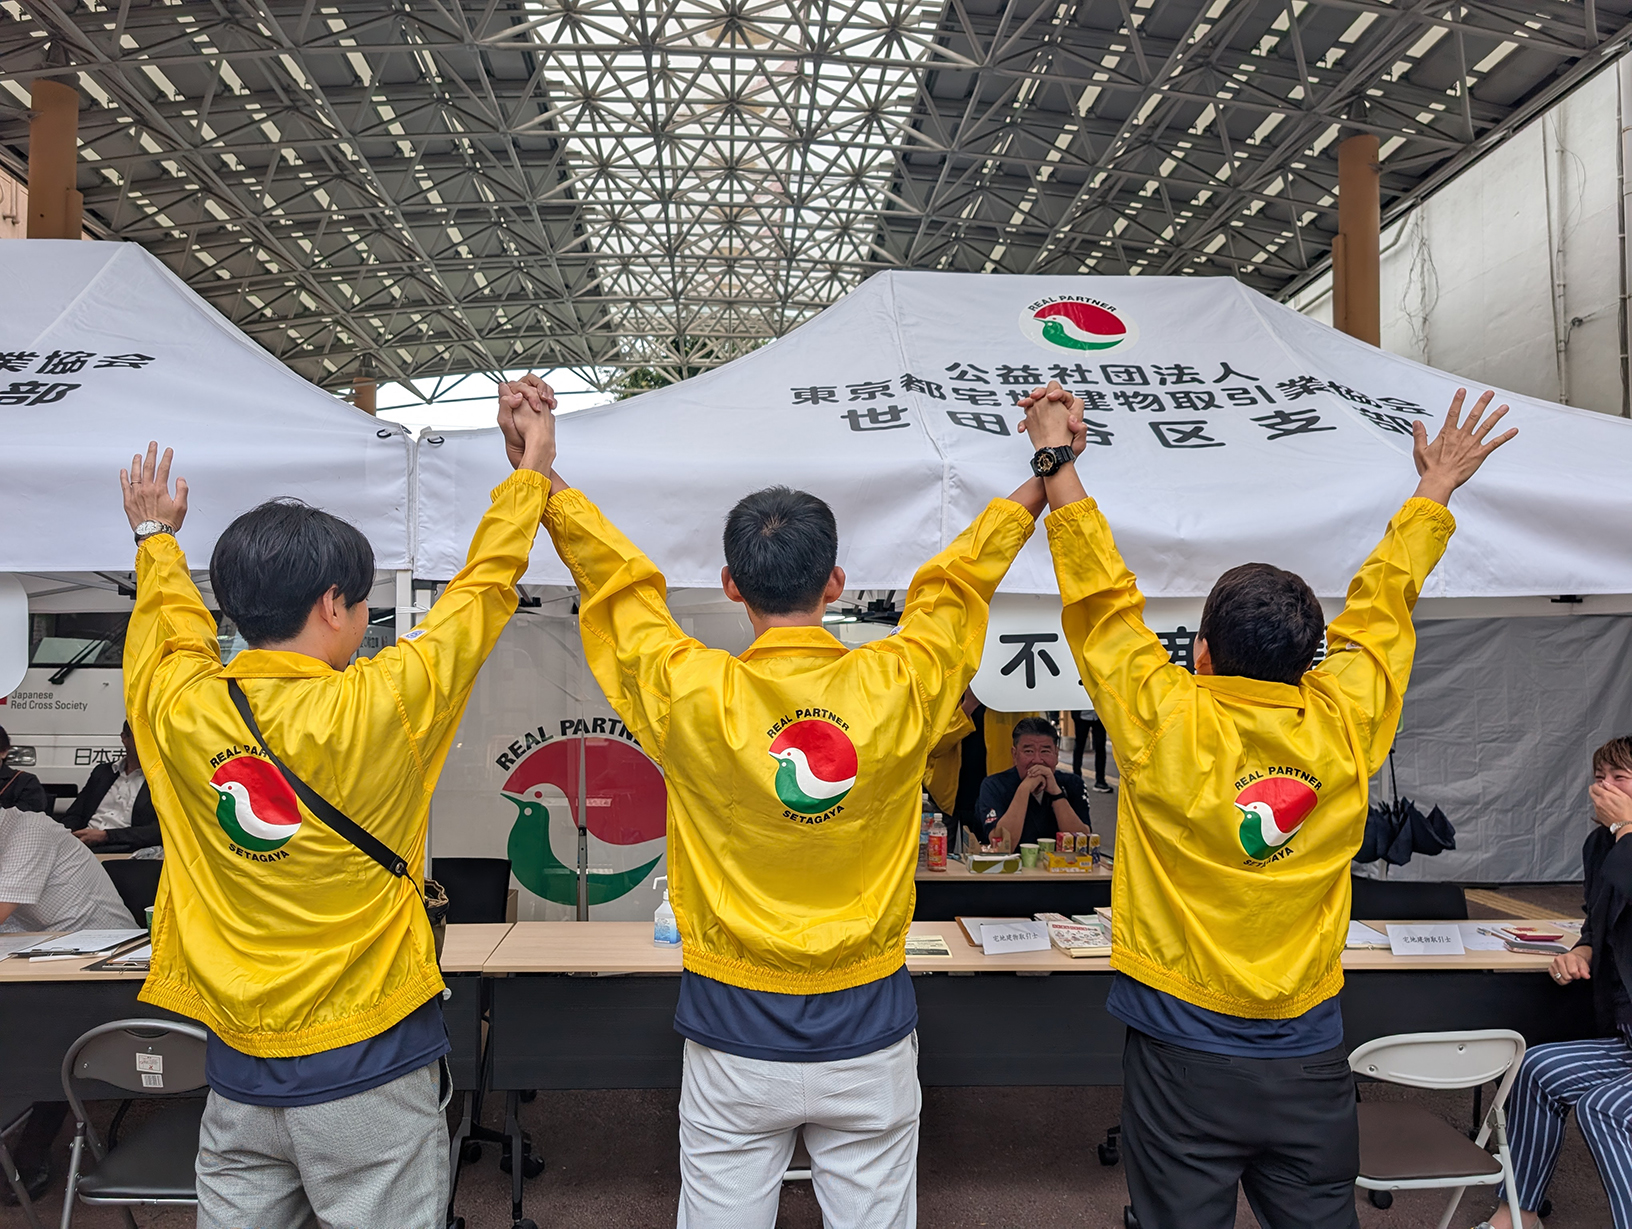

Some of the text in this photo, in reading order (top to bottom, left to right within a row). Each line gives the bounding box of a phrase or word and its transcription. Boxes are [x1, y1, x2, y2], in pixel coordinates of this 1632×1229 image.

[1028, 295, 1117, 312] REAL PARTNER
[944, 361, 1260, 386] 公益社団法人
[11, 701, 88, 711] Red Cross Society
[12, 691, 54, 700] Japanese
[767, 708, 850, 739] REAL PARTNER
[495, 717, 644, 772] REAL PARTN
[210, 746, 242, 768] REAL
[1235, 766, 1322, 791] REAL PARTNER
[782, 805, 845, 825] SETAGAYA
[229, 843, 290, 863] SETAGAYA
